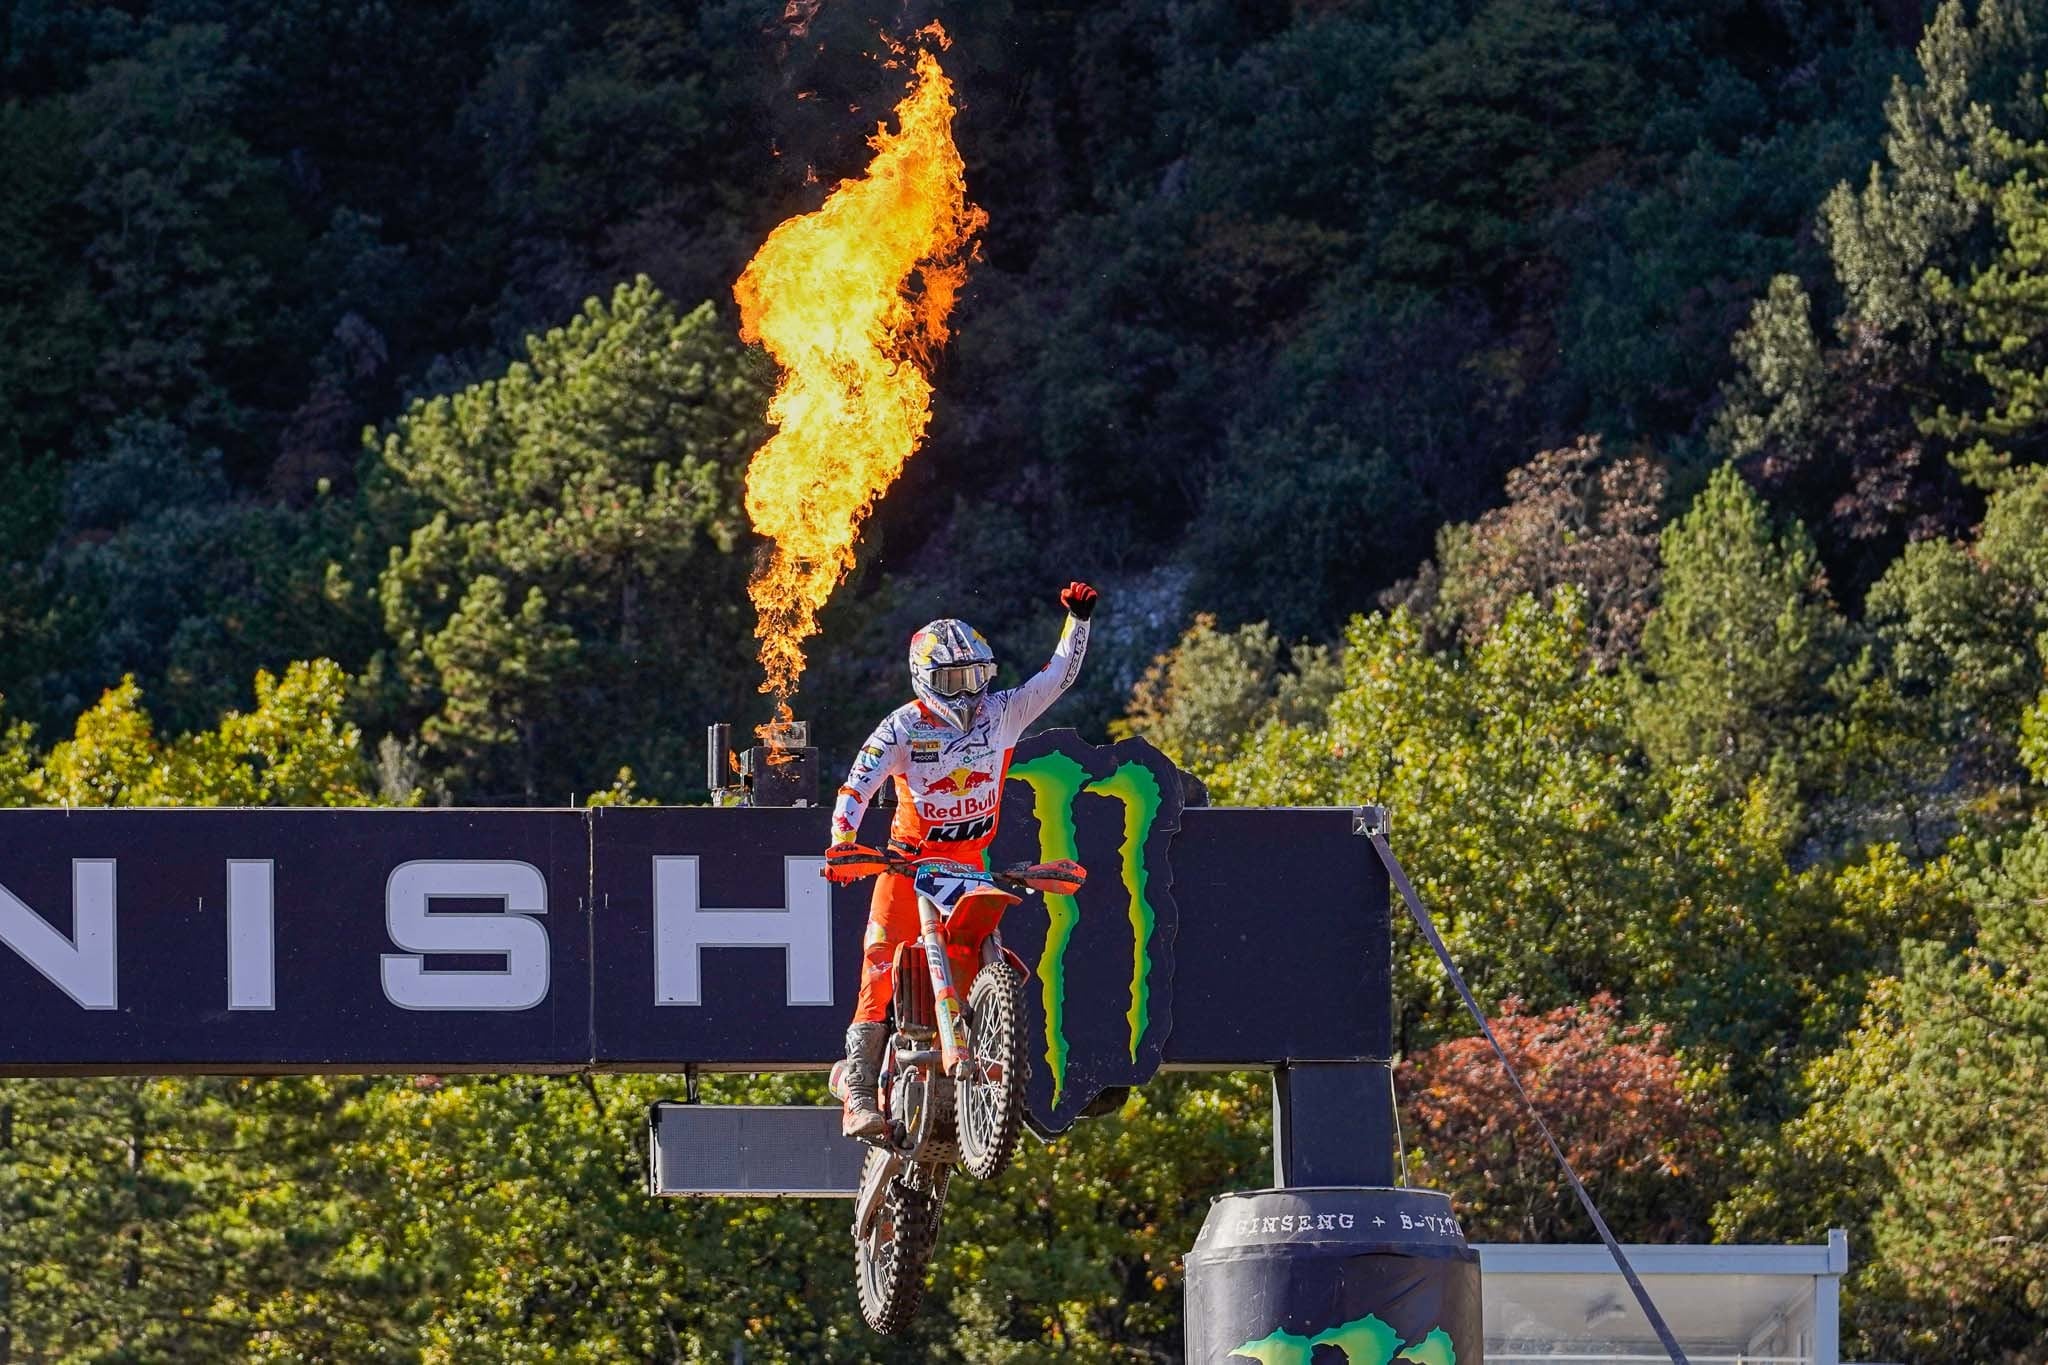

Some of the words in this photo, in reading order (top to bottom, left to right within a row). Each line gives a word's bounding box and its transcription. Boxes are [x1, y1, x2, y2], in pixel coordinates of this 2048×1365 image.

[924, 800, 962, 819] Red
[965, 788, 996, 816] Bull
[926, 814, 996, 842] KTM
[1236, 1213, 1355, 1237] GINSENG
